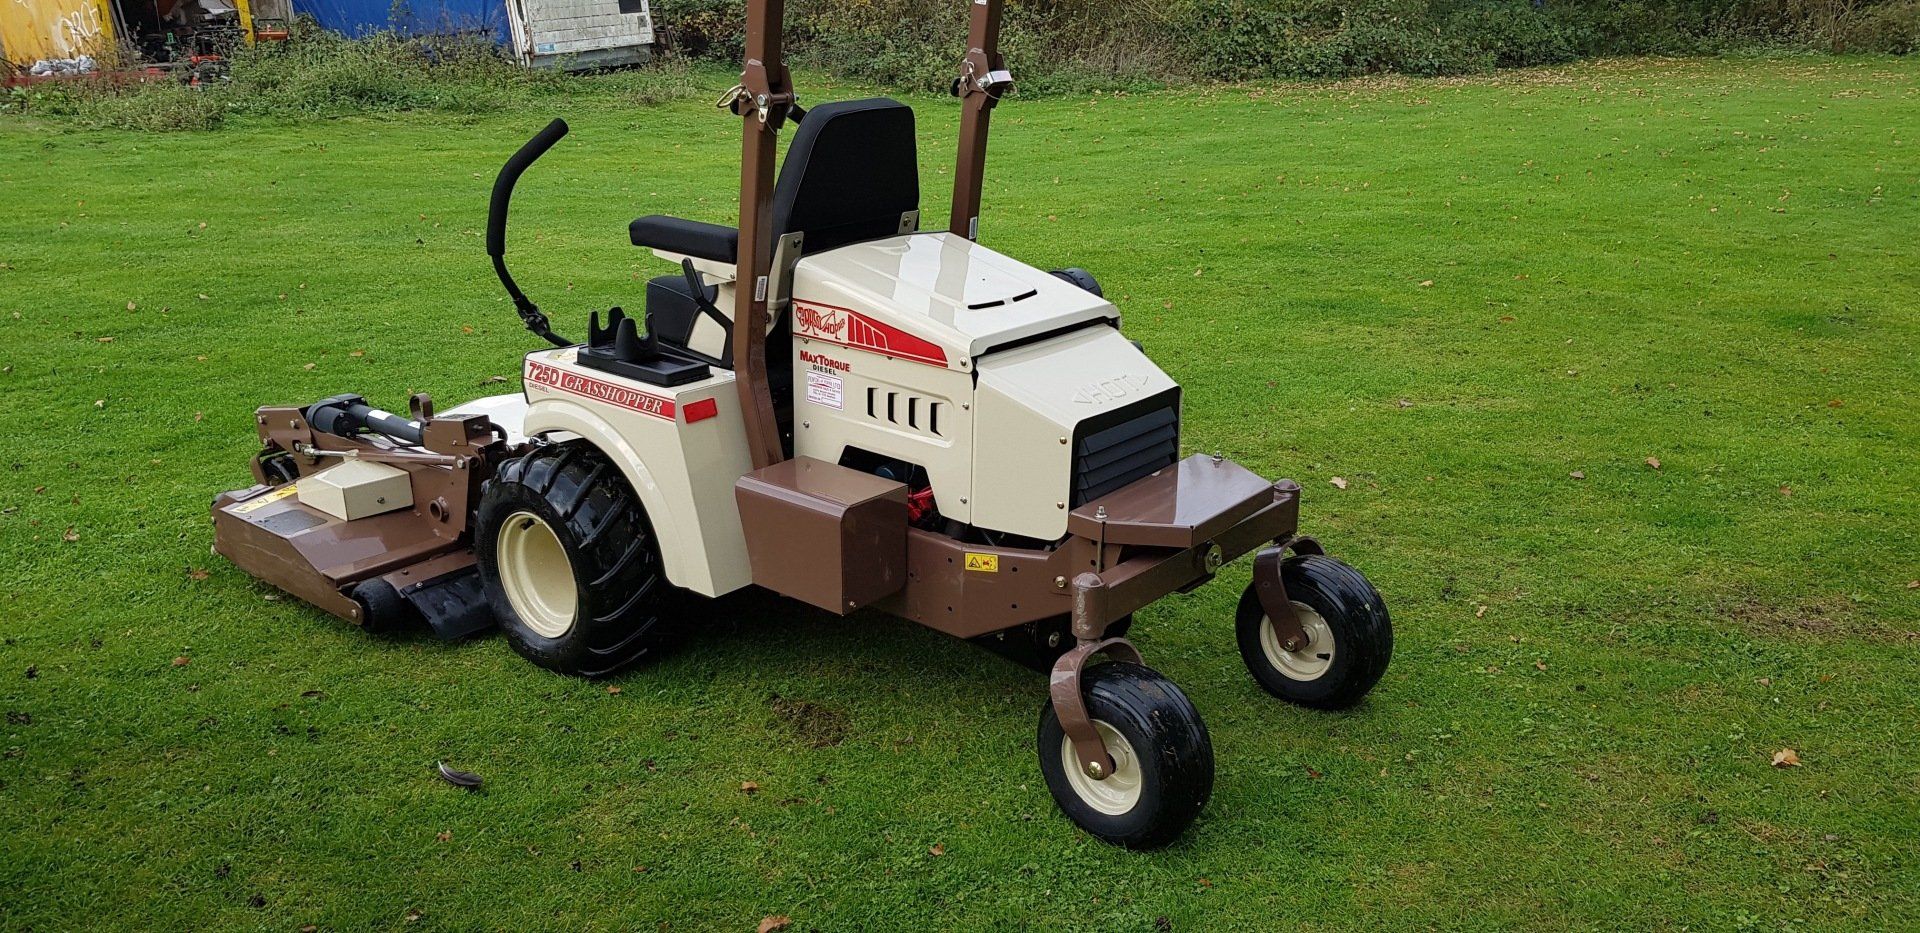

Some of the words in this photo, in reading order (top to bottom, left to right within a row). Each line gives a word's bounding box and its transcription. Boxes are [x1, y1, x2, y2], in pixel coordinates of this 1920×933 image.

[812, 364, 837, 376] DIESEL
[528, 381, 550, 394] DIESEL
[528, 362, 560, 386] 725D
[564, 375, 663, 414] GRASSHOPPER
